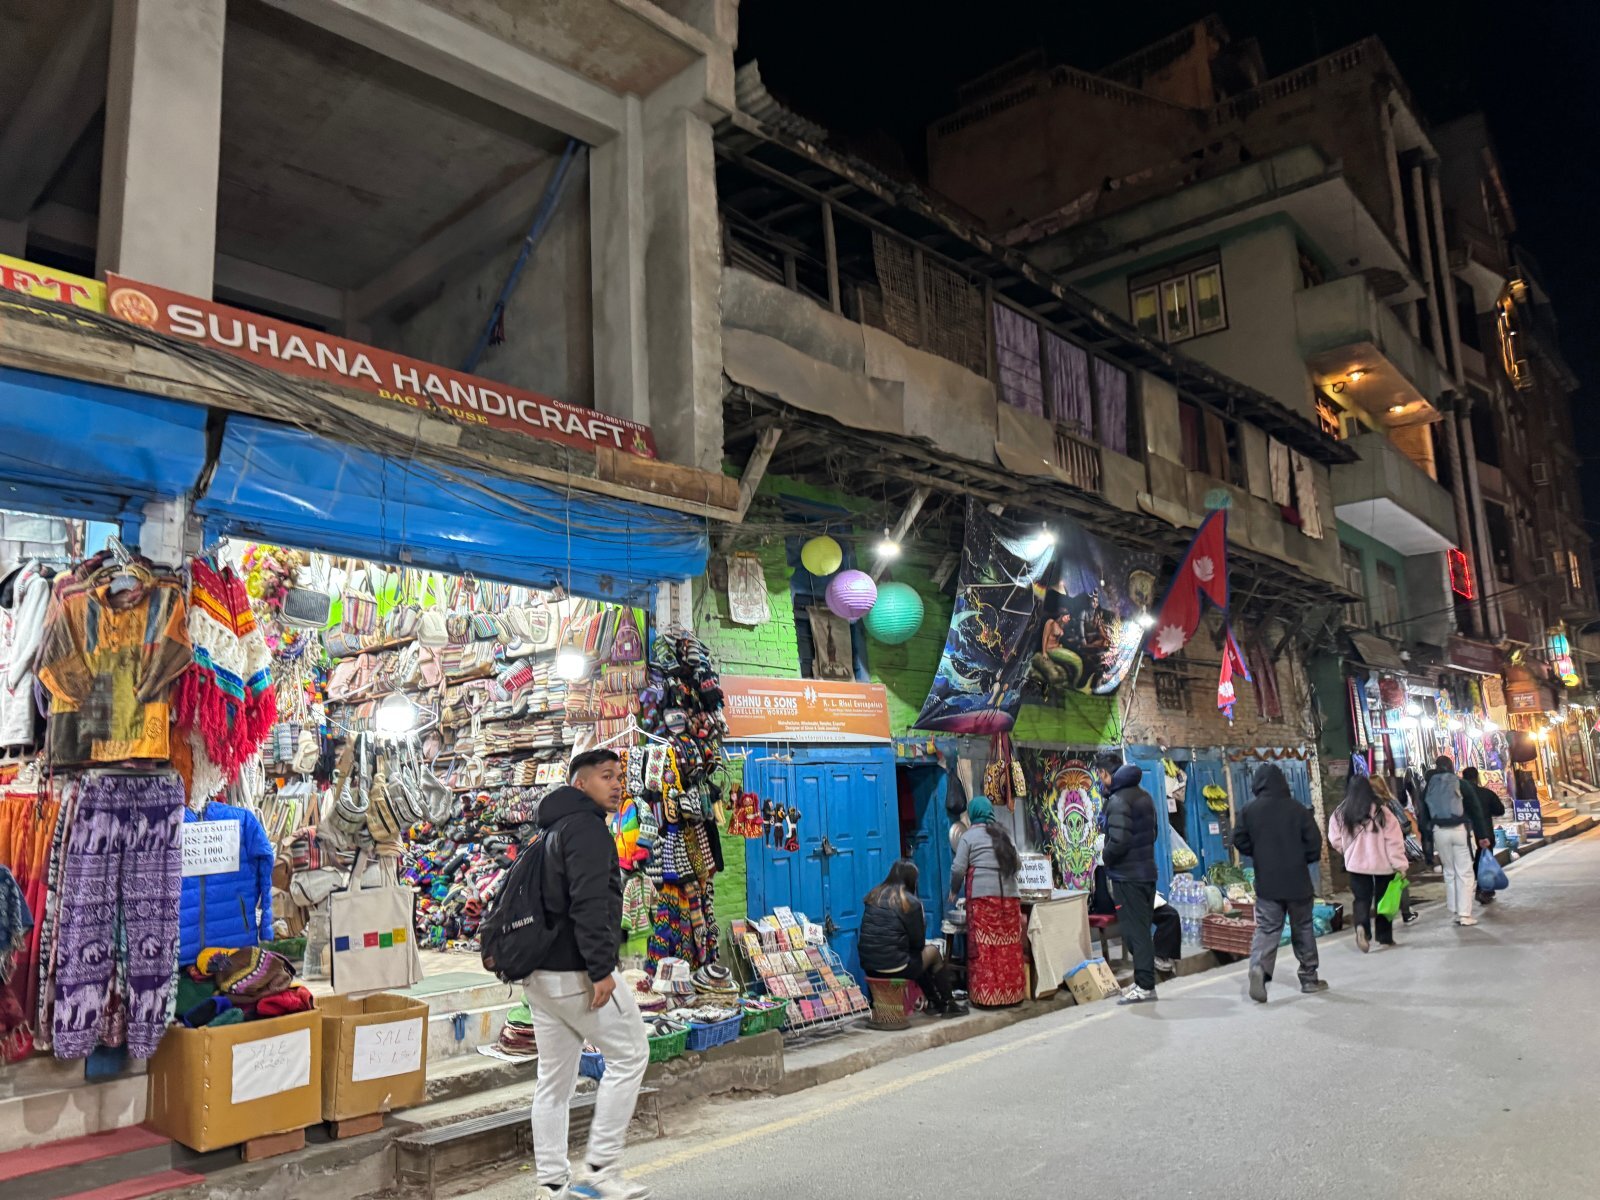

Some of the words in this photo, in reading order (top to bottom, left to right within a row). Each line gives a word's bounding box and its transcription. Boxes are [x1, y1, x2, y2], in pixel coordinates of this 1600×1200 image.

[166, 303, 383, 385] SUHANA
[391, 361, 625, 449] HANDICRAFT
[377, 387, 419, 407] BAG
[727, 694, 762, 708] VISHNU
[763, 696, 772, 708] &
[773, 696, 799, 709] SONS
[203, 834, 223, 844] 2200
[203, 846, 223, 856] 1000
[375, 1024, 416, 1046] SALE
